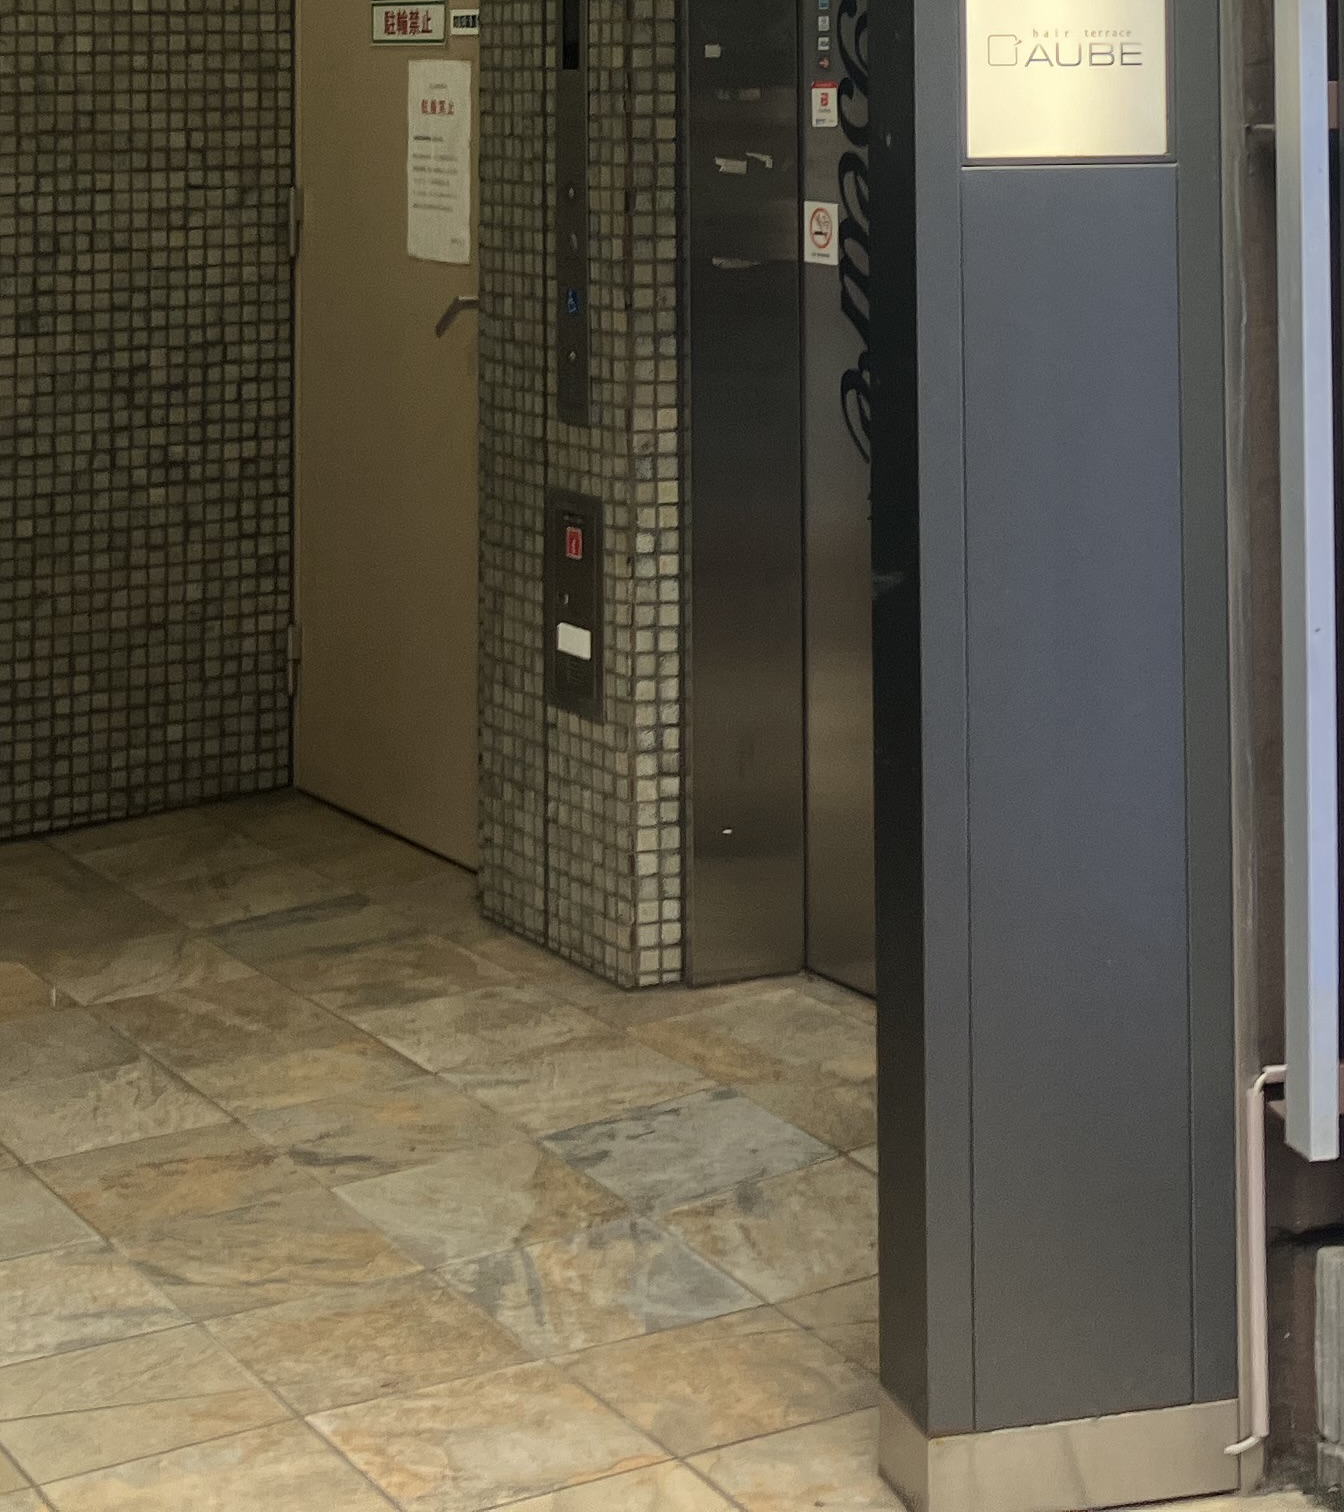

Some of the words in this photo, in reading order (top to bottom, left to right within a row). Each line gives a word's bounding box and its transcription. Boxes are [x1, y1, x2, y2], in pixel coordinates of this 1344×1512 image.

[383, 10, 433, 36] 駐輪禁止
[1084, 29, 1132, 38] terrace
[1024, 42, 1143, 68] AUBE
